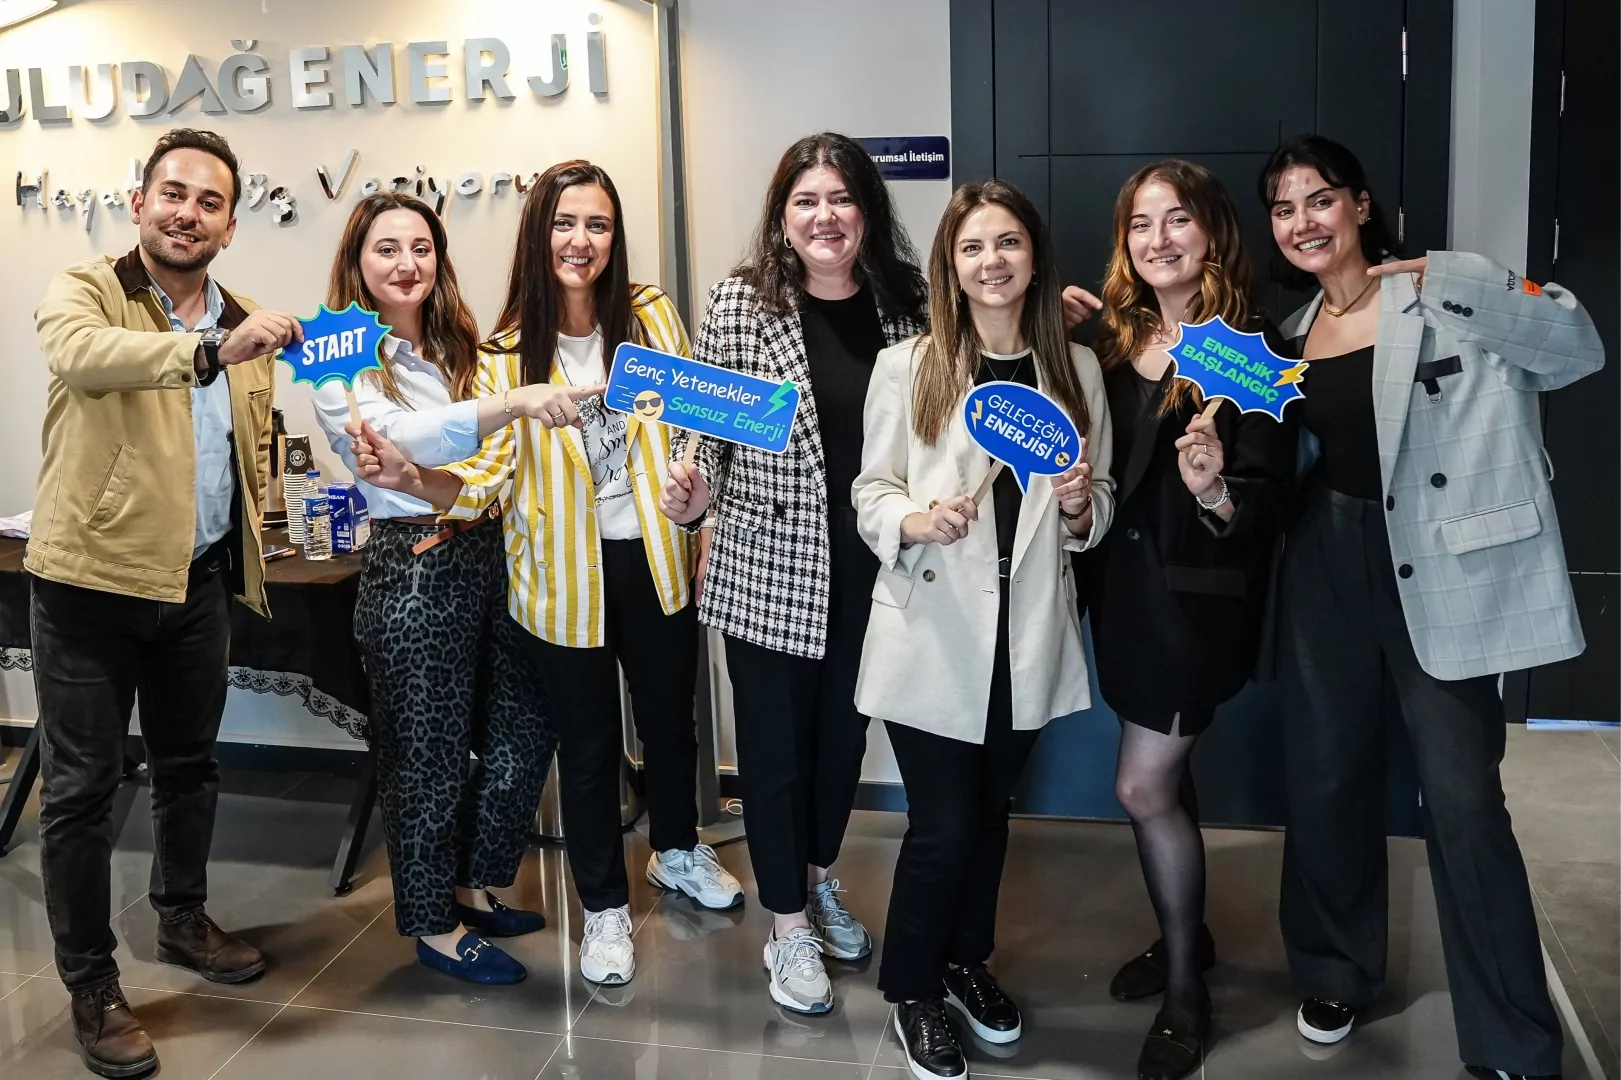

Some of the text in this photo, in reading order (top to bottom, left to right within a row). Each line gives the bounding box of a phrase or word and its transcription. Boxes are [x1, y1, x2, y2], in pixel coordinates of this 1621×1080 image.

[289, 12, 608, 108] ENERJİ
[868, 150, 944, 162] urumsal İletişim
[16, 157, 143, 230] Hayat
[316, 148, 542, 217] Veriyoru
[302, 326, 367, 366] START
[1202, 336, 1276, 382] ENERJİK
[624, 357, 761, 407] Genç Yetenekler
[1180, 343, 1280, 404] BAŞLANGIÇ
[607, 420, 626, 436] AND
[667, 396, 786, 442] Sonsuz Enerji
[983, 413, 1055, 460] ENERJİSİ
[987, 394, 1070, 448] GELECEĞİN
